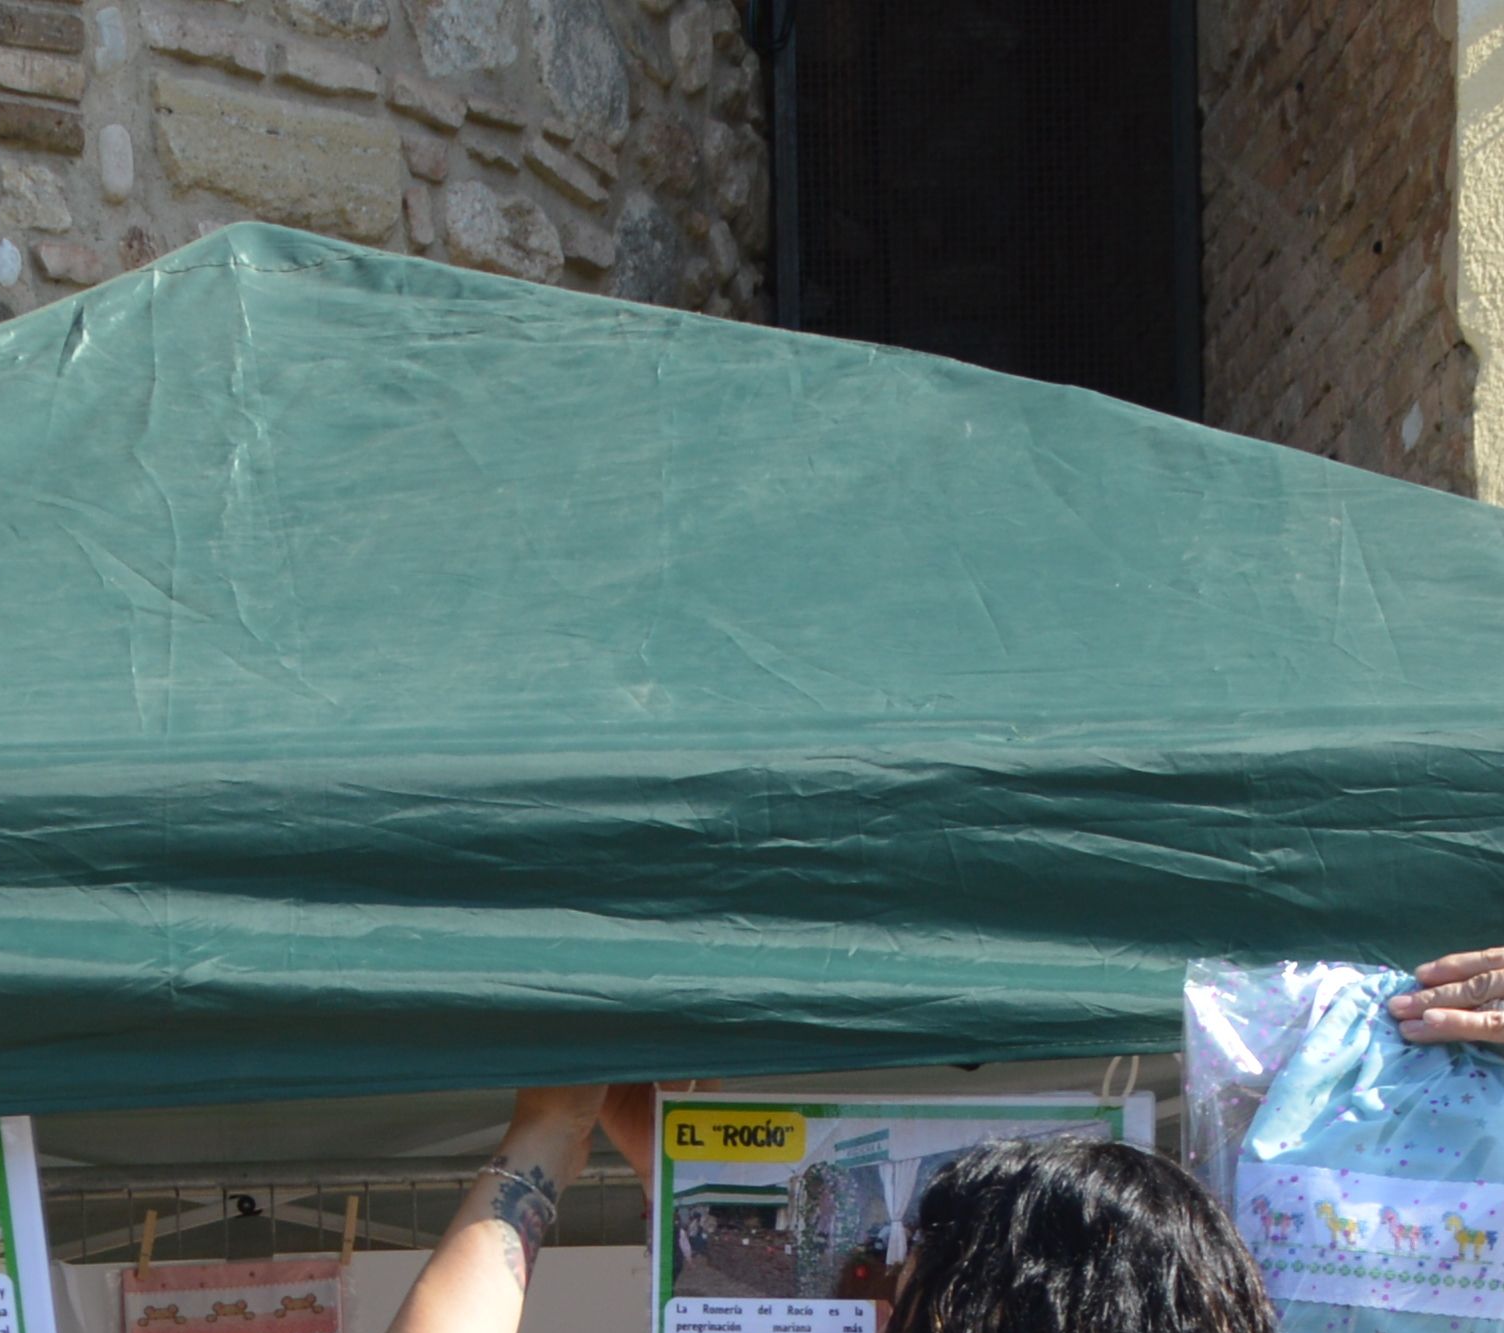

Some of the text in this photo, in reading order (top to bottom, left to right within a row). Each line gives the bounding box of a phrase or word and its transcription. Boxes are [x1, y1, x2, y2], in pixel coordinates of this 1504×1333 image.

[677, 1124, 704, 1146] EL
[676, 1304, 687, 1314] La
[703, 1304, 742, 1315] Romería
[758, 1305, 772, 1315] del
[829, 1308, 839, 1316] es
[855, 1306, 863, 1316] la
[676, 1321, 863, 1333] peregrinación mariana más
